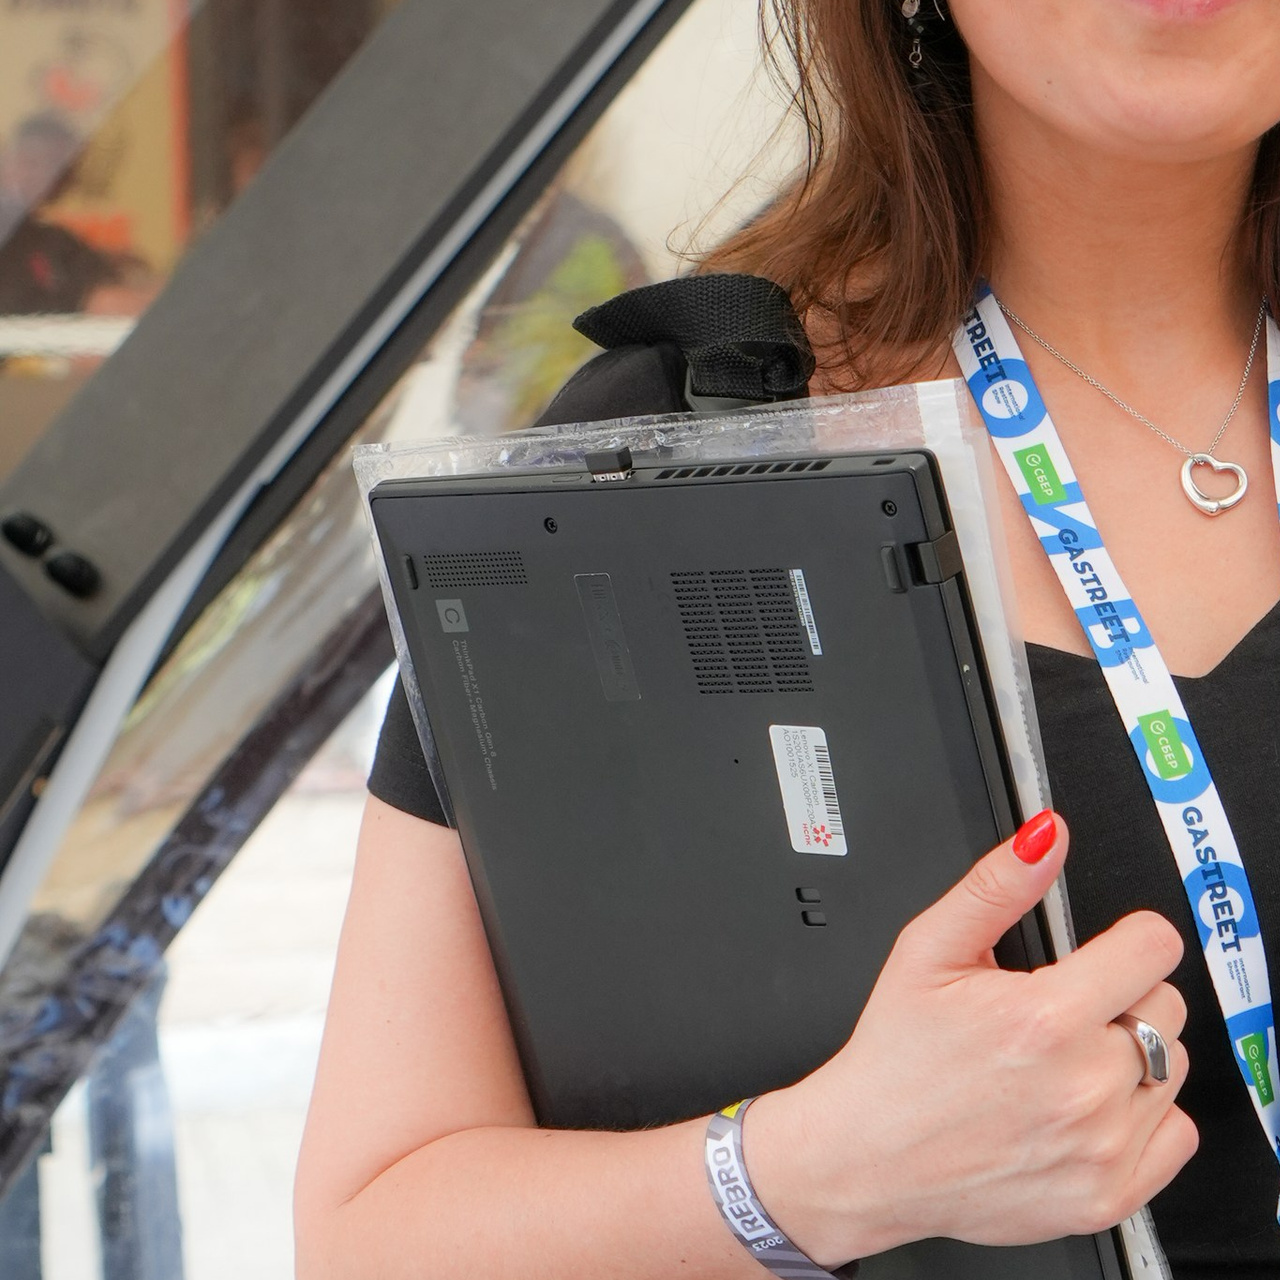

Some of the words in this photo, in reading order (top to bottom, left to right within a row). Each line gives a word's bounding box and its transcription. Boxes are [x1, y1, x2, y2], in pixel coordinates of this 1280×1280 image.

[963, 307, 1007, 383] TREET
[1033, 467, 1054, 497] СБЕР
[1058, 528, 1130, 644] GASTREET
[452, 639, 465, 673] Carbon
[462, 674, 473, 698] Fiber
[470, 704, 488, 755] Magnesium
[460, 639, 478, 681] ThinkPad
[475, 697, 489, 730] Carbon
[800, 729, 811, 761] Lenovo
[1157, 736, 1179, 769] СБЕР
[807, 762, 815, 774] X1
[810, 773, 820, 806] Carbon
[1182, 806, 1241, 953] GASTREET
[1253, 1062, 1267, 1096] СБЕР
[712, 1146, 766, 1235] REBRO
[752, 1236, 784, 1252] 2023
